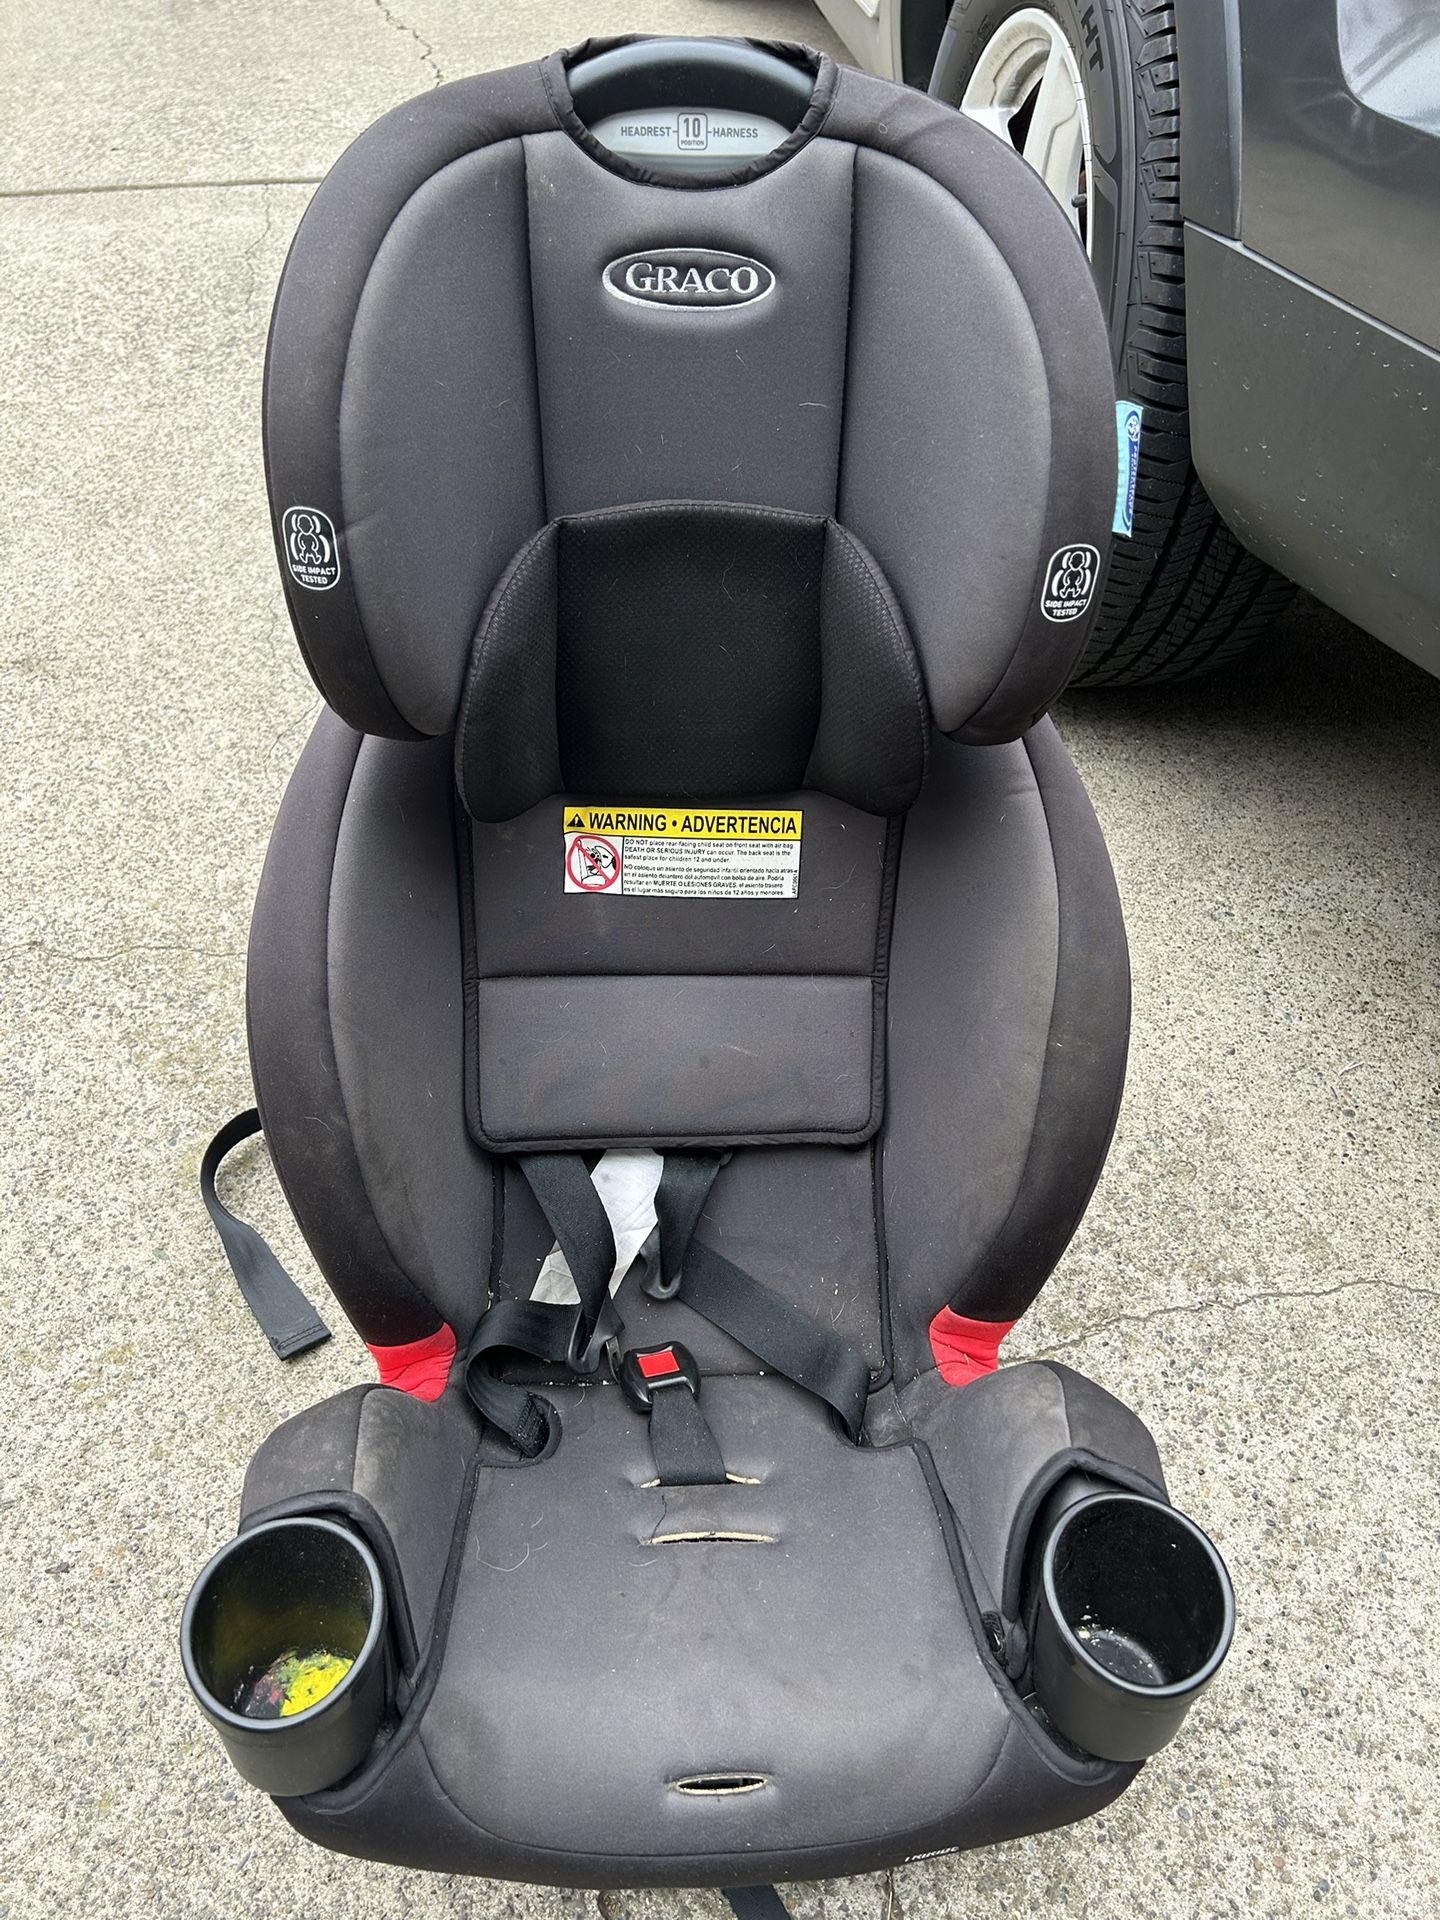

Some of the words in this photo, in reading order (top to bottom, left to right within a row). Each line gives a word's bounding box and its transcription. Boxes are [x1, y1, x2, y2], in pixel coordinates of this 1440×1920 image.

[620, 126, 672, 137] HEADREST
[683, 117, 701, 138] 10
[712, 127, 759, 138] HARNESS
[625, 262, 759, 294] GRACO
[292, 564, 307, 573] SIDE
[307, 566, 336, 575] IMPACT
[300, 574, 328, 584] TESTED
[1045, 600, 1063, 608] SIDE
[1063, 599, 1087, 607] IMPACT
[1052, 608, 1078, 616] TESTED
[588, 812, 667, 832] WARNING
[681, 815, 797, 834] ADVERTENCIA
